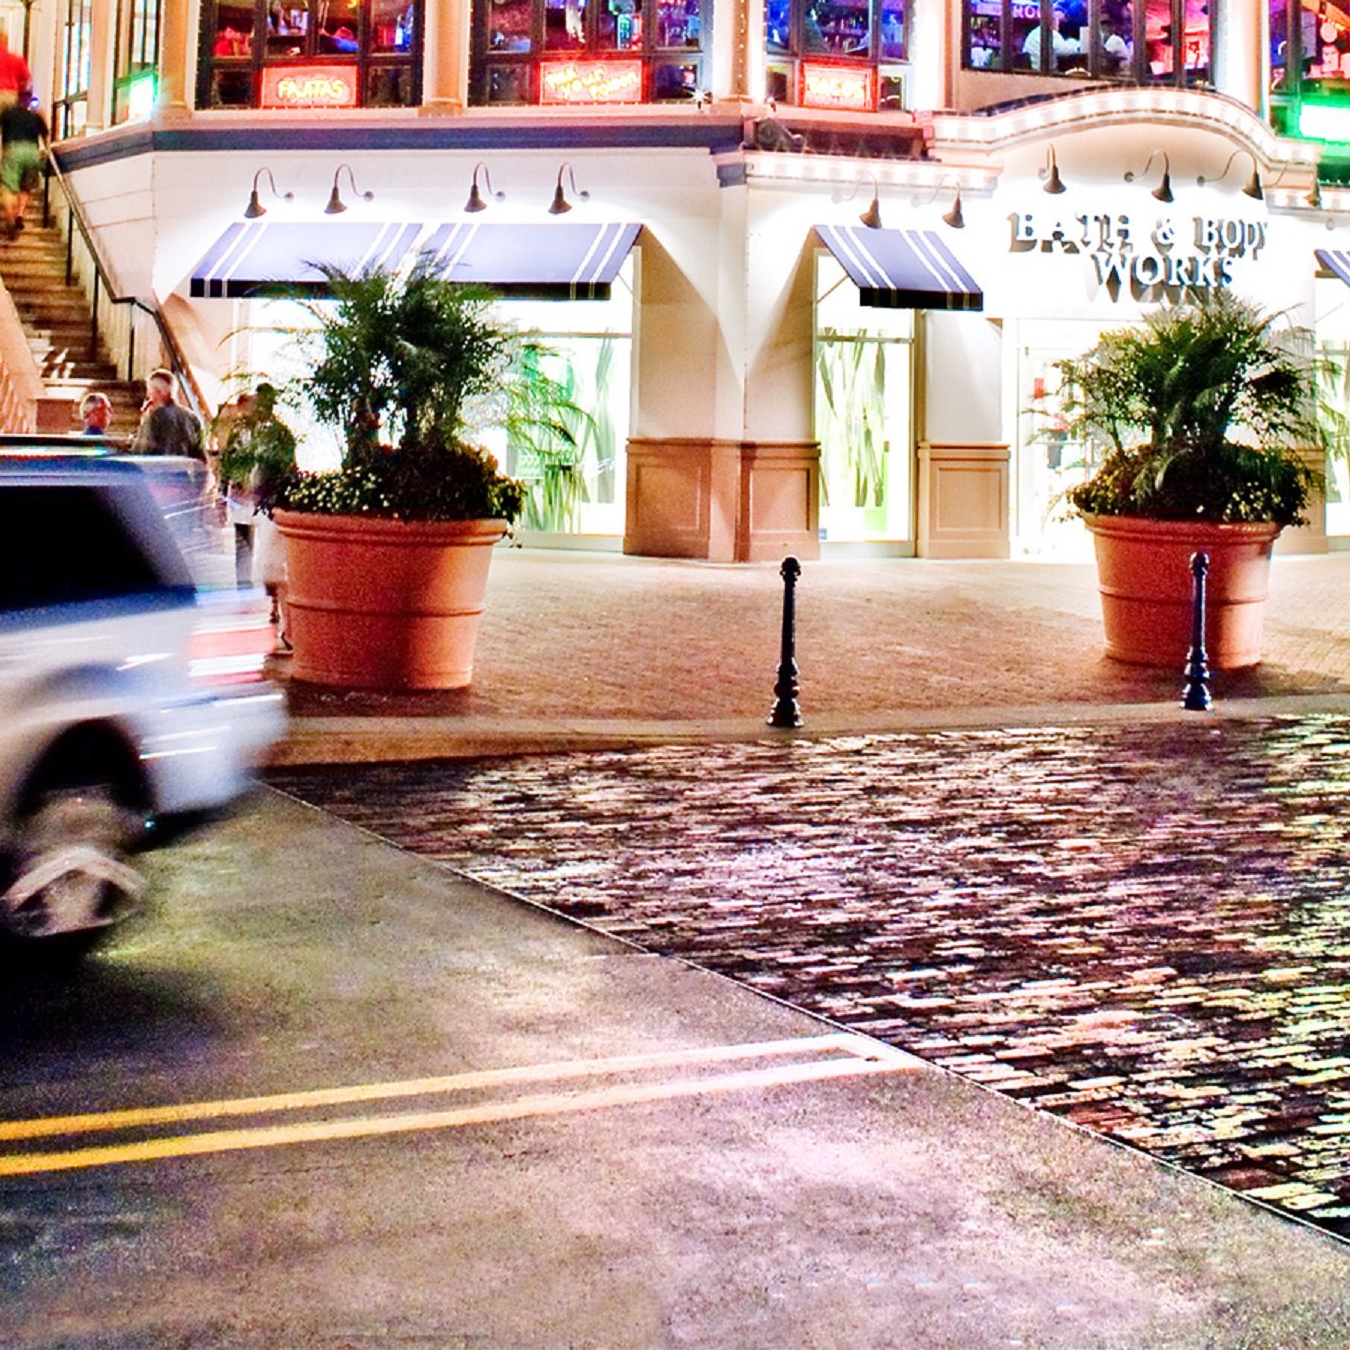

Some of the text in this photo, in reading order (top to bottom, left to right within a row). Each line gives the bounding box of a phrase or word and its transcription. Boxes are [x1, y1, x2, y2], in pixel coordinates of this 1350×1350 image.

[1007, 212, 1134, 253] BATH
[1191, 215, 1269, 256] BODY
[1089, 250, 1238, 288] WORKS
